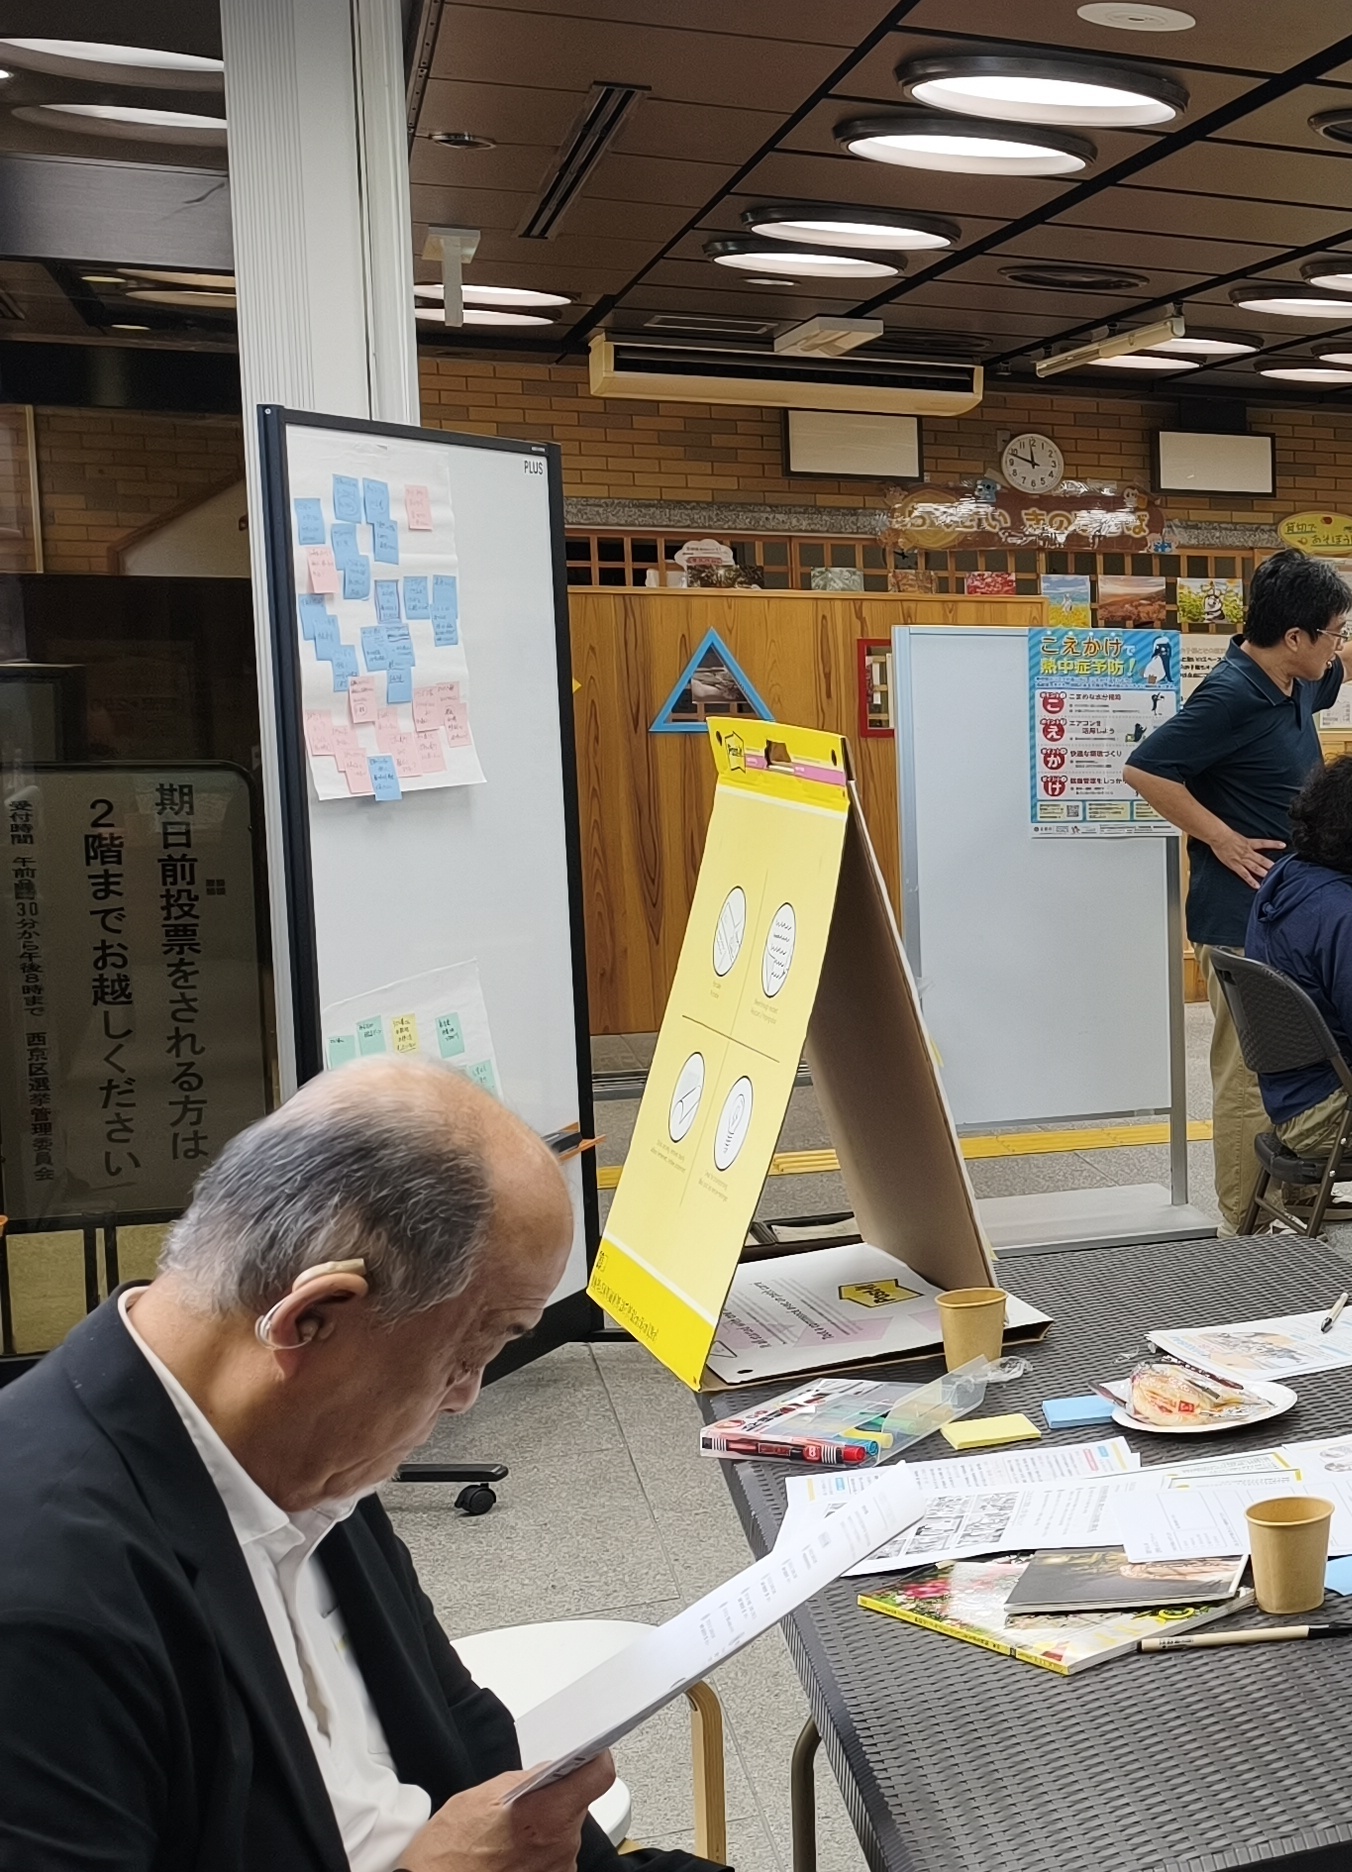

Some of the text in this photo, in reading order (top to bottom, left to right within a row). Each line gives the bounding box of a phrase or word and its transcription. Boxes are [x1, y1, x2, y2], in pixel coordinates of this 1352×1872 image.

[524, 460, 544, 476] PLUS
[1041, 636, 1135, 657] こえかけで
[1040, 658, 1137, 677] 熱中症予防！
[1046, 727, 1061, 739] え
[1048, 755, 1061, 768] か
[1049, 782, 1062, 795] け
[155, 783, 209, 1161] 期日前投票をされる方は
[9, 800, 55, 1182] 受付時間 西京区選挙管理委員会
[84, 799, 141, 1177] 2階までお越しください
